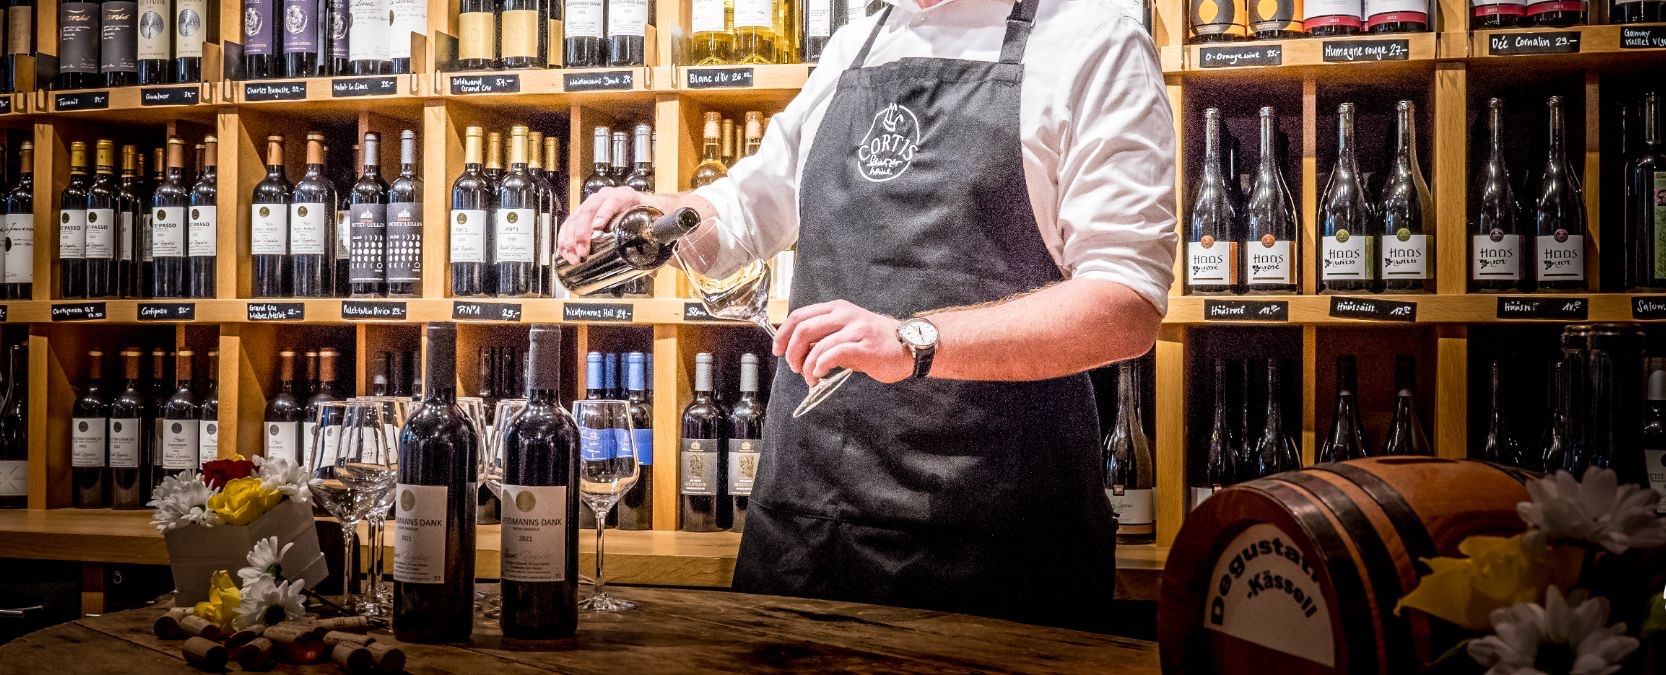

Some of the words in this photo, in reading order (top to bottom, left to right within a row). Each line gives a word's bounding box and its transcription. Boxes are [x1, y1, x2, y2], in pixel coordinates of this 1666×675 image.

[1515, 37, 1550, 47] Cornalin
[1325, 44, 1363, 60] Humagne
[1365, 46, 1387, 60] rouge
[689, 73, 713, 83] Blanc
[461, 84, 480, 92] Grand
[859, 134, 918, 160] CORTIS
[419, 518, 443, 527] DANK
[541, 518, 563, 526] DANK
